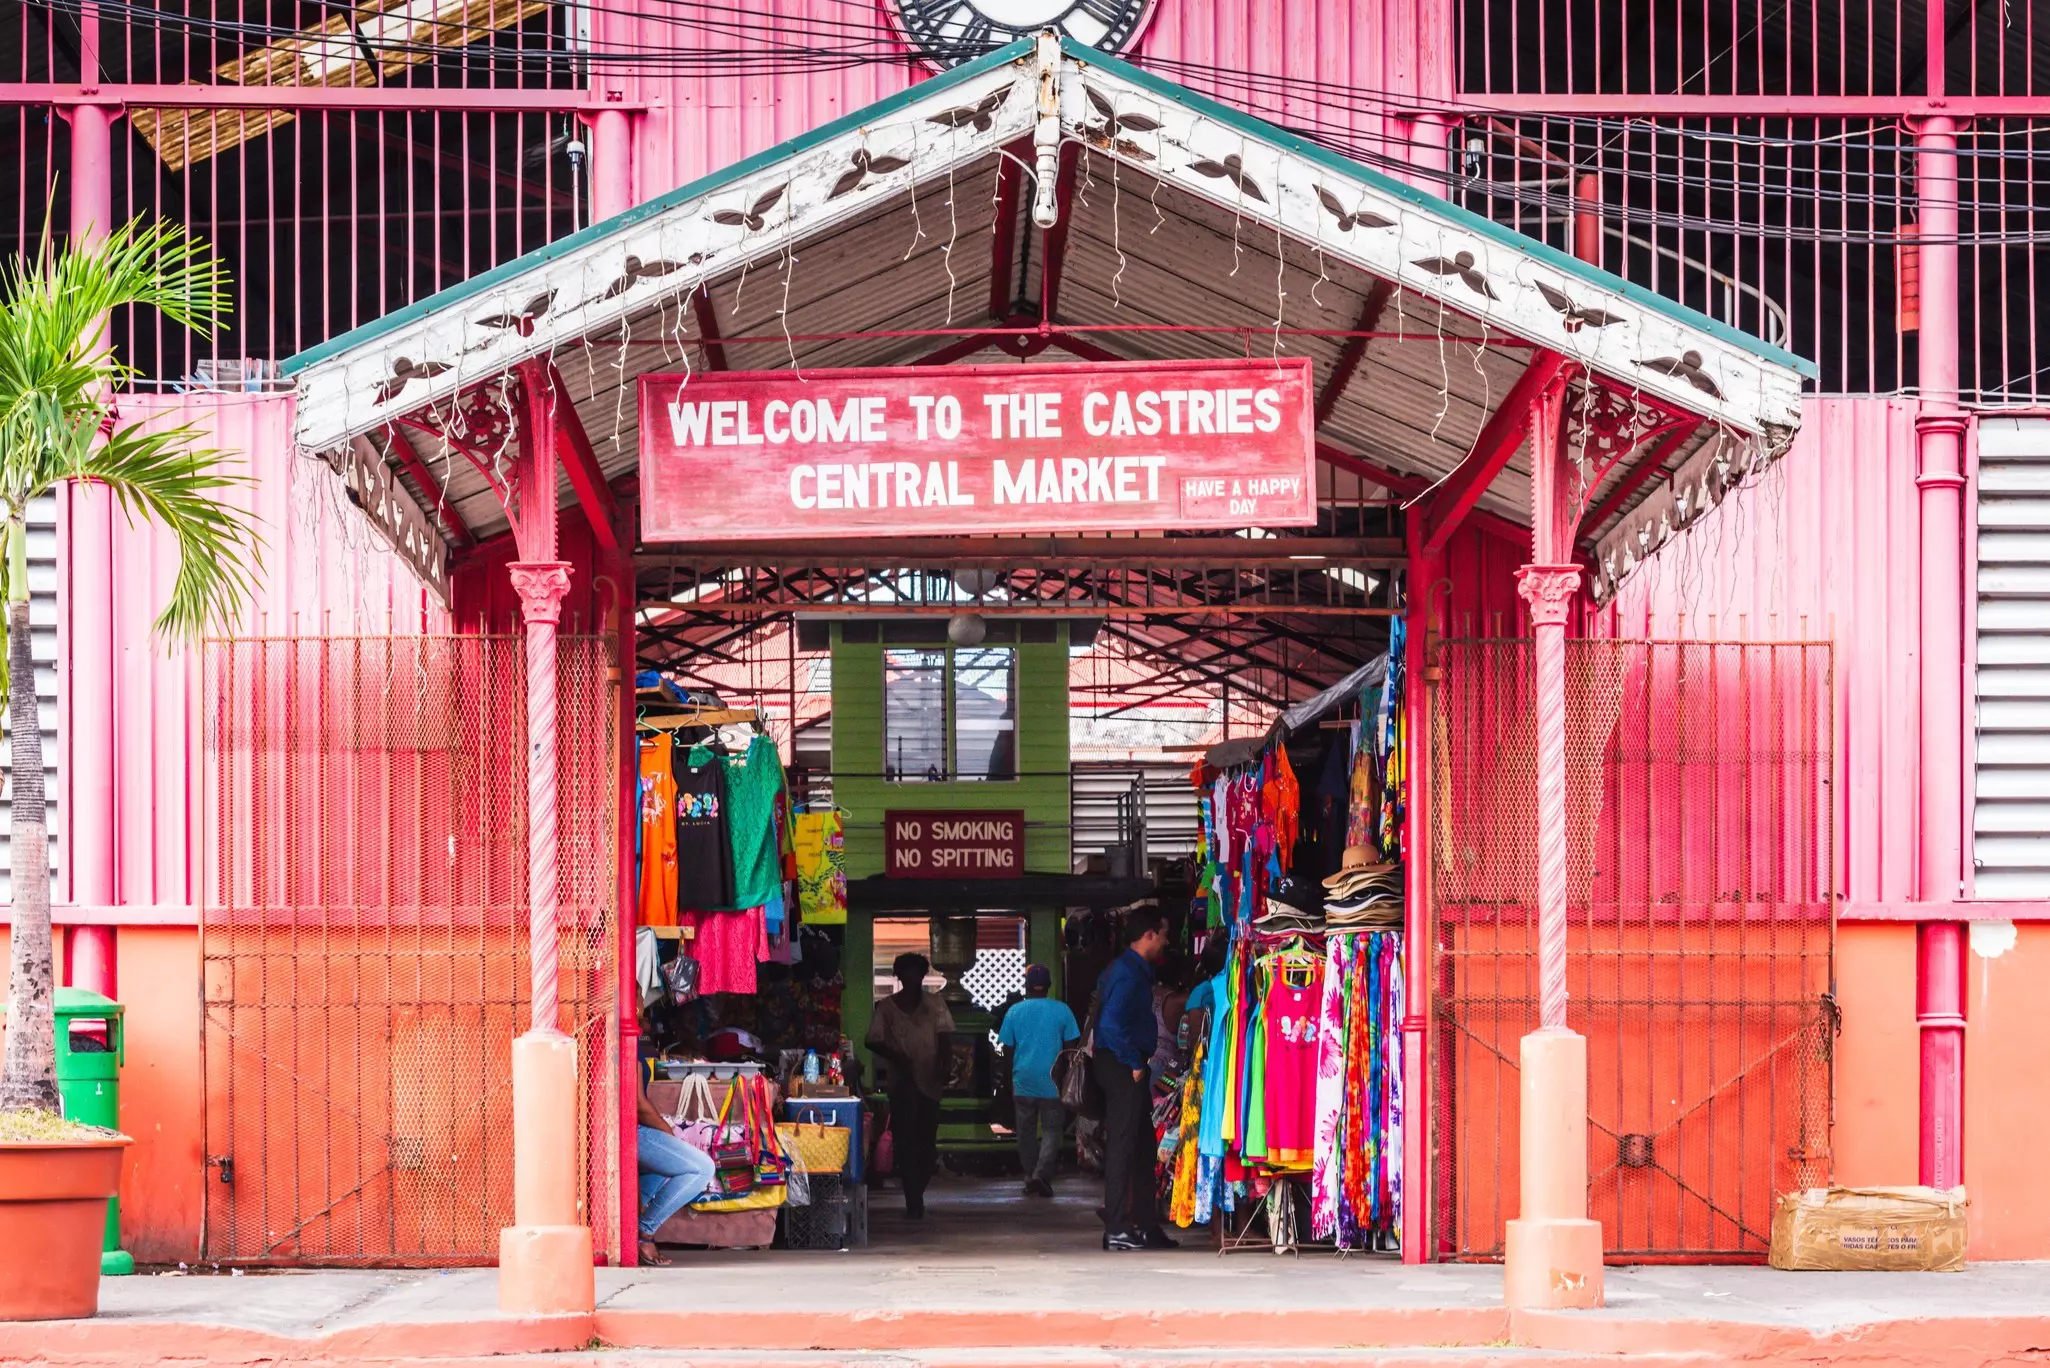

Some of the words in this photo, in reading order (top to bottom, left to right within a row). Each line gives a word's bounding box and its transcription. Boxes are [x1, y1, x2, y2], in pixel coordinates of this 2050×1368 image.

[668, 397, 887, 446] WELCOME
[909, 396, 962, 440] TO
[984, 393, 1062, 439] THE
[1083, 389, 1281, 437] CASTRIES
[790, 461, 974, 509] CENTRAL
[993, 456, 1166, 505] MARKET
[1186, 480, 1224, 497] HAVE
[1232, 479, 1242, 496] A
[1248, 478, 1300, 498] HAPPY
[1230, 499, 1257, 516] DAY
[895, 821, 922, 841] NO
[931, 821, 1014, 841] SMOKING
[895, 848, 922, 868] NO
[931, 848, 1014, 868] SPITTING
